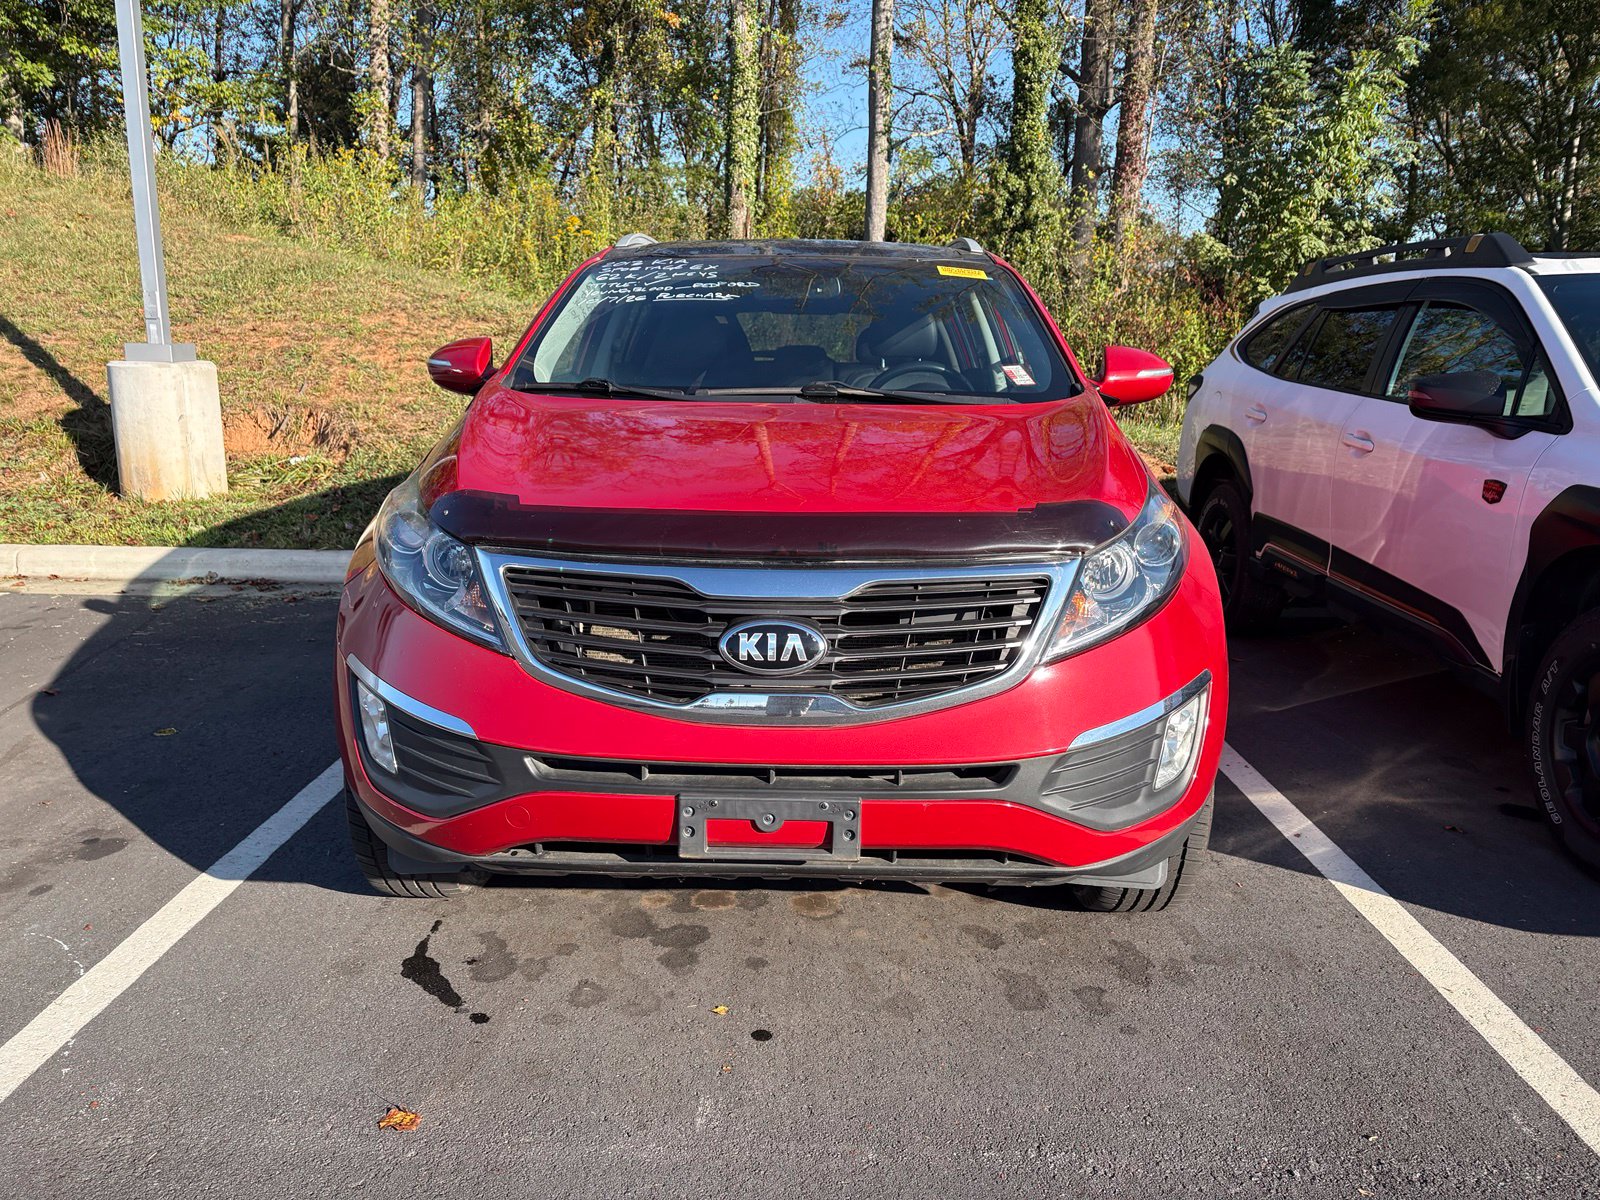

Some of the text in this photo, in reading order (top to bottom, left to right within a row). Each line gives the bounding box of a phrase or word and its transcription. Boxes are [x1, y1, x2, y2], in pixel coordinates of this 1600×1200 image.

[652, 258, 689, 266] KIA
[689, 263, 719, 271] EX
[738, 632, 808, 662] KIA
[1531, 659, 1562, 825] GEOLANDAR A/T
